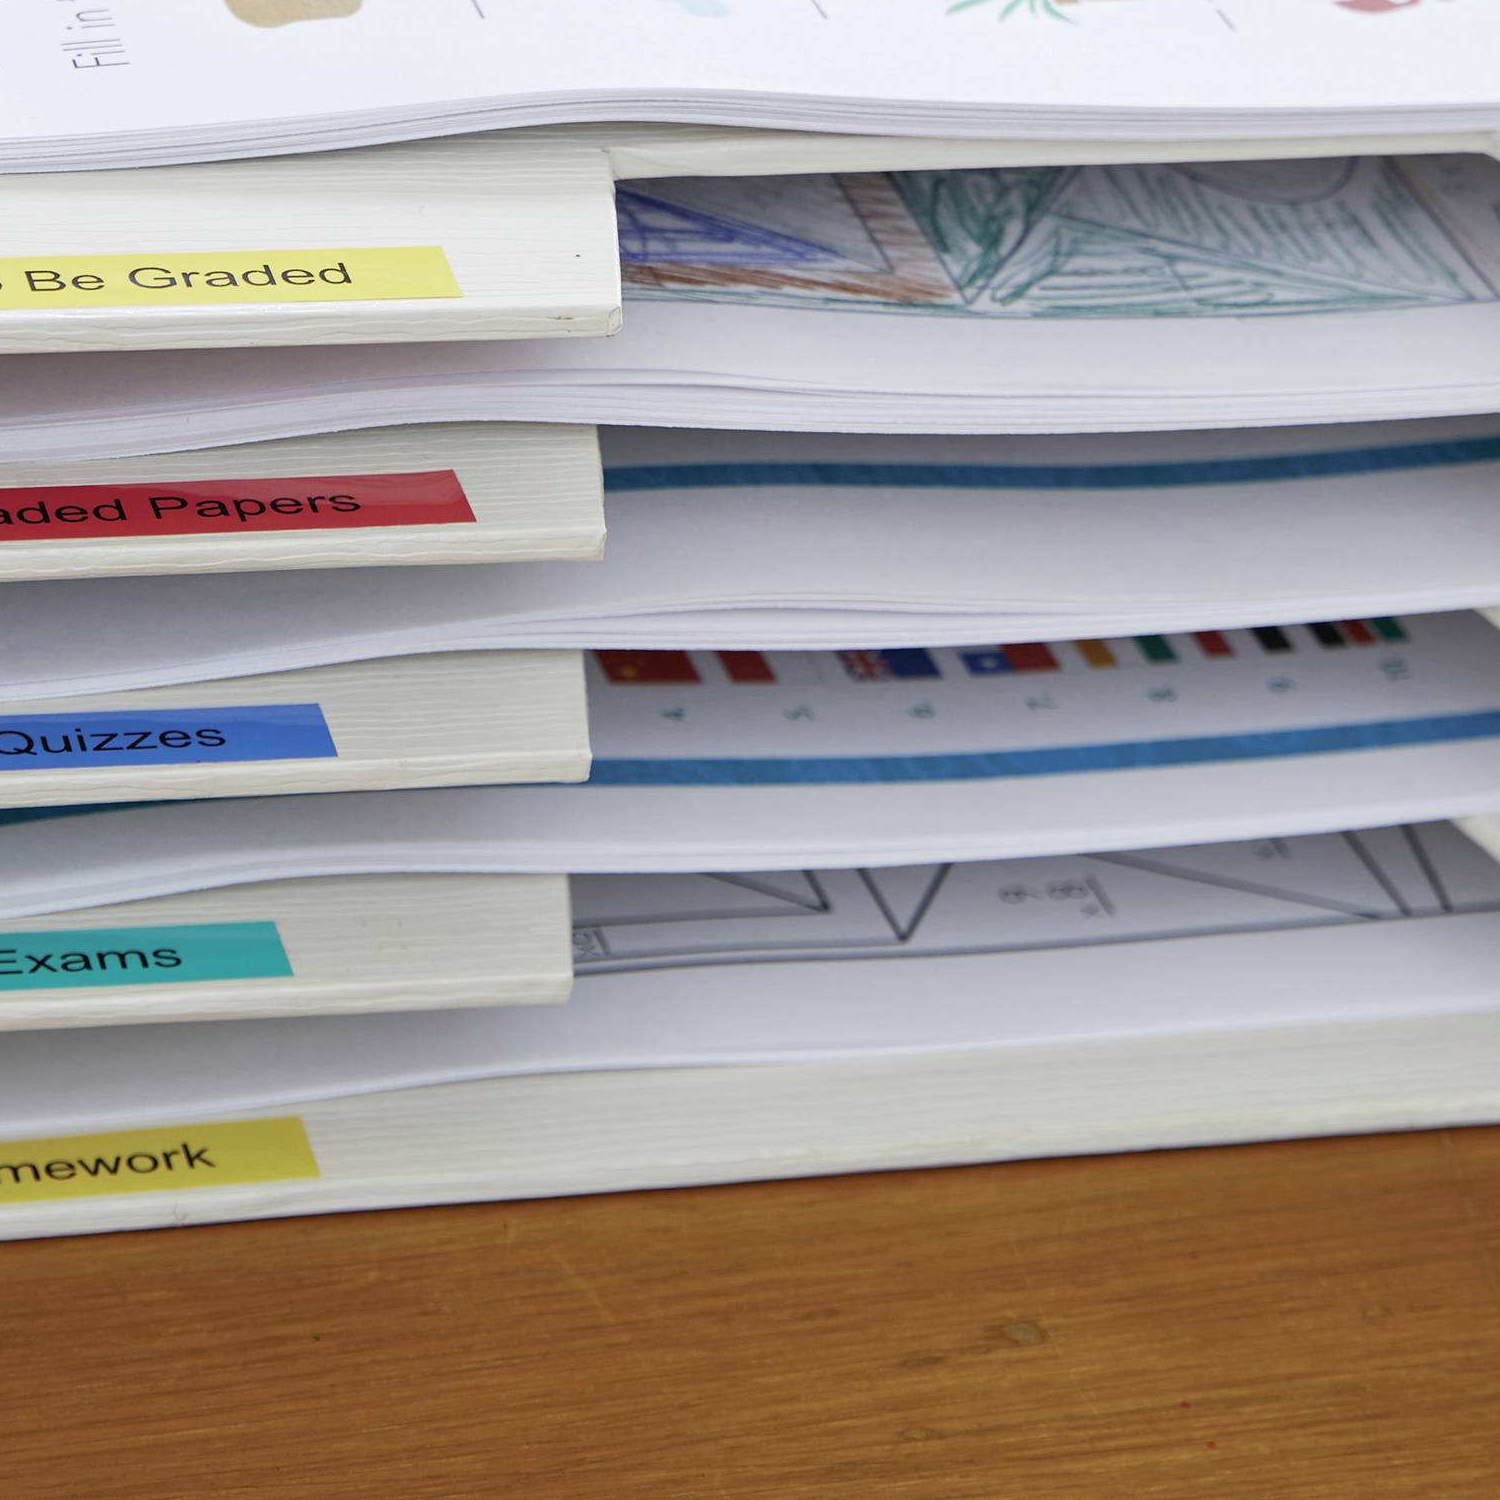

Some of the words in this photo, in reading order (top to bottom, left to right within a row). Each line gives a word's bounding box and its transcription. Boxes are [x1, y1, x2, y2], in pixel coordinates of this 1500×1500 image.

[64, 8, 116, 31] in
[60, 37, 131, 69] Fill
[24, 269, 106, 292] Be
[127, 262, 353, 289] Graded
[148, 489, 362, 528] Papers
